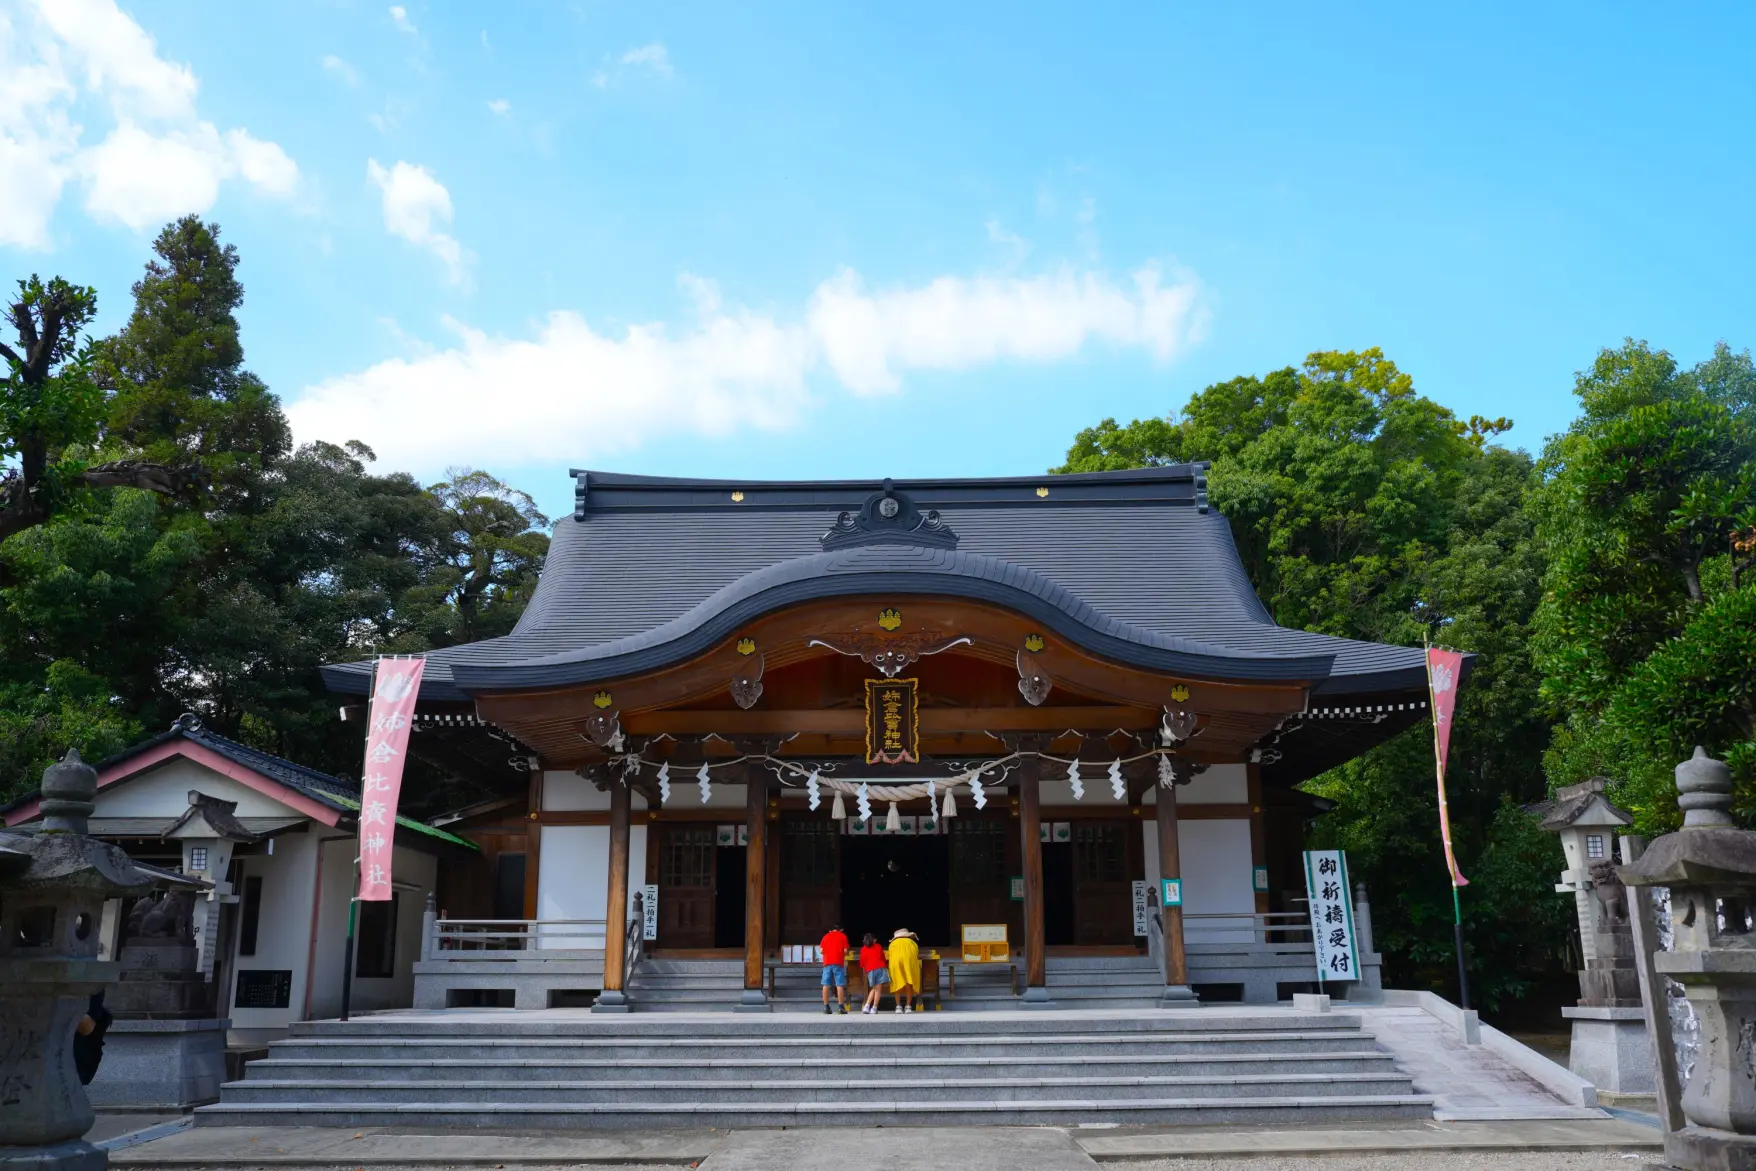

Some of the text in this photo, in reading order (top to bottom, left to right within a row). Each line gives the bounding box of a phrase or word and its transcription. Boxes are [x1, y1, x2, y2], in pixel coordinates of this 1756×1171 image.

[645, 886, 656, 937] 二礼二拍手一礼
[1134, 882, 1147, 934] 二礼二拍手一礼
